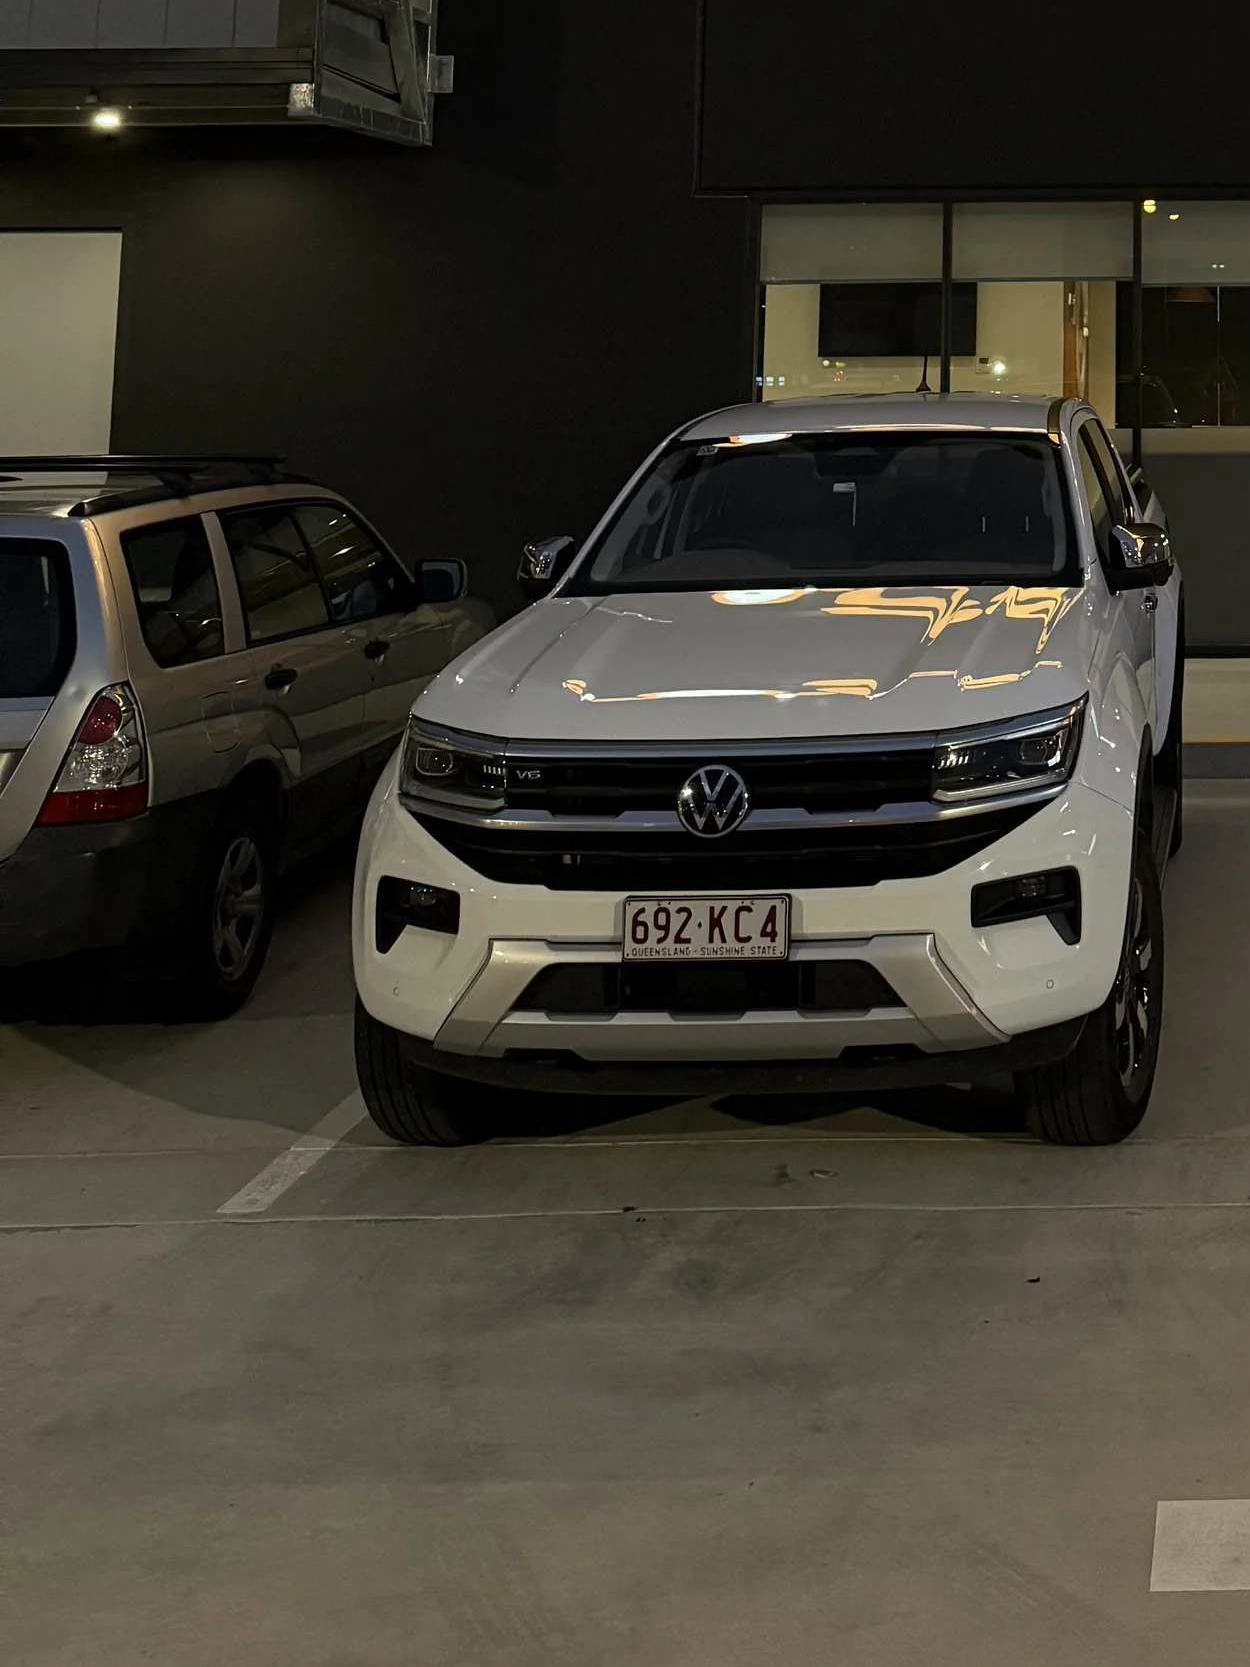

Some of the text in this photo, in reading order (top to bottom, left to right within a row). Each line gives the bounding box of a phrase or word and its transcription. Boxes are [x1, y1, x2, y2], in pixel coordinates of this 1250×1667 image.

[516, 769, 541, 780] V6
[700, 946, 745, 956] SUNSHINE
[750, 945, 777, 955] STATE
